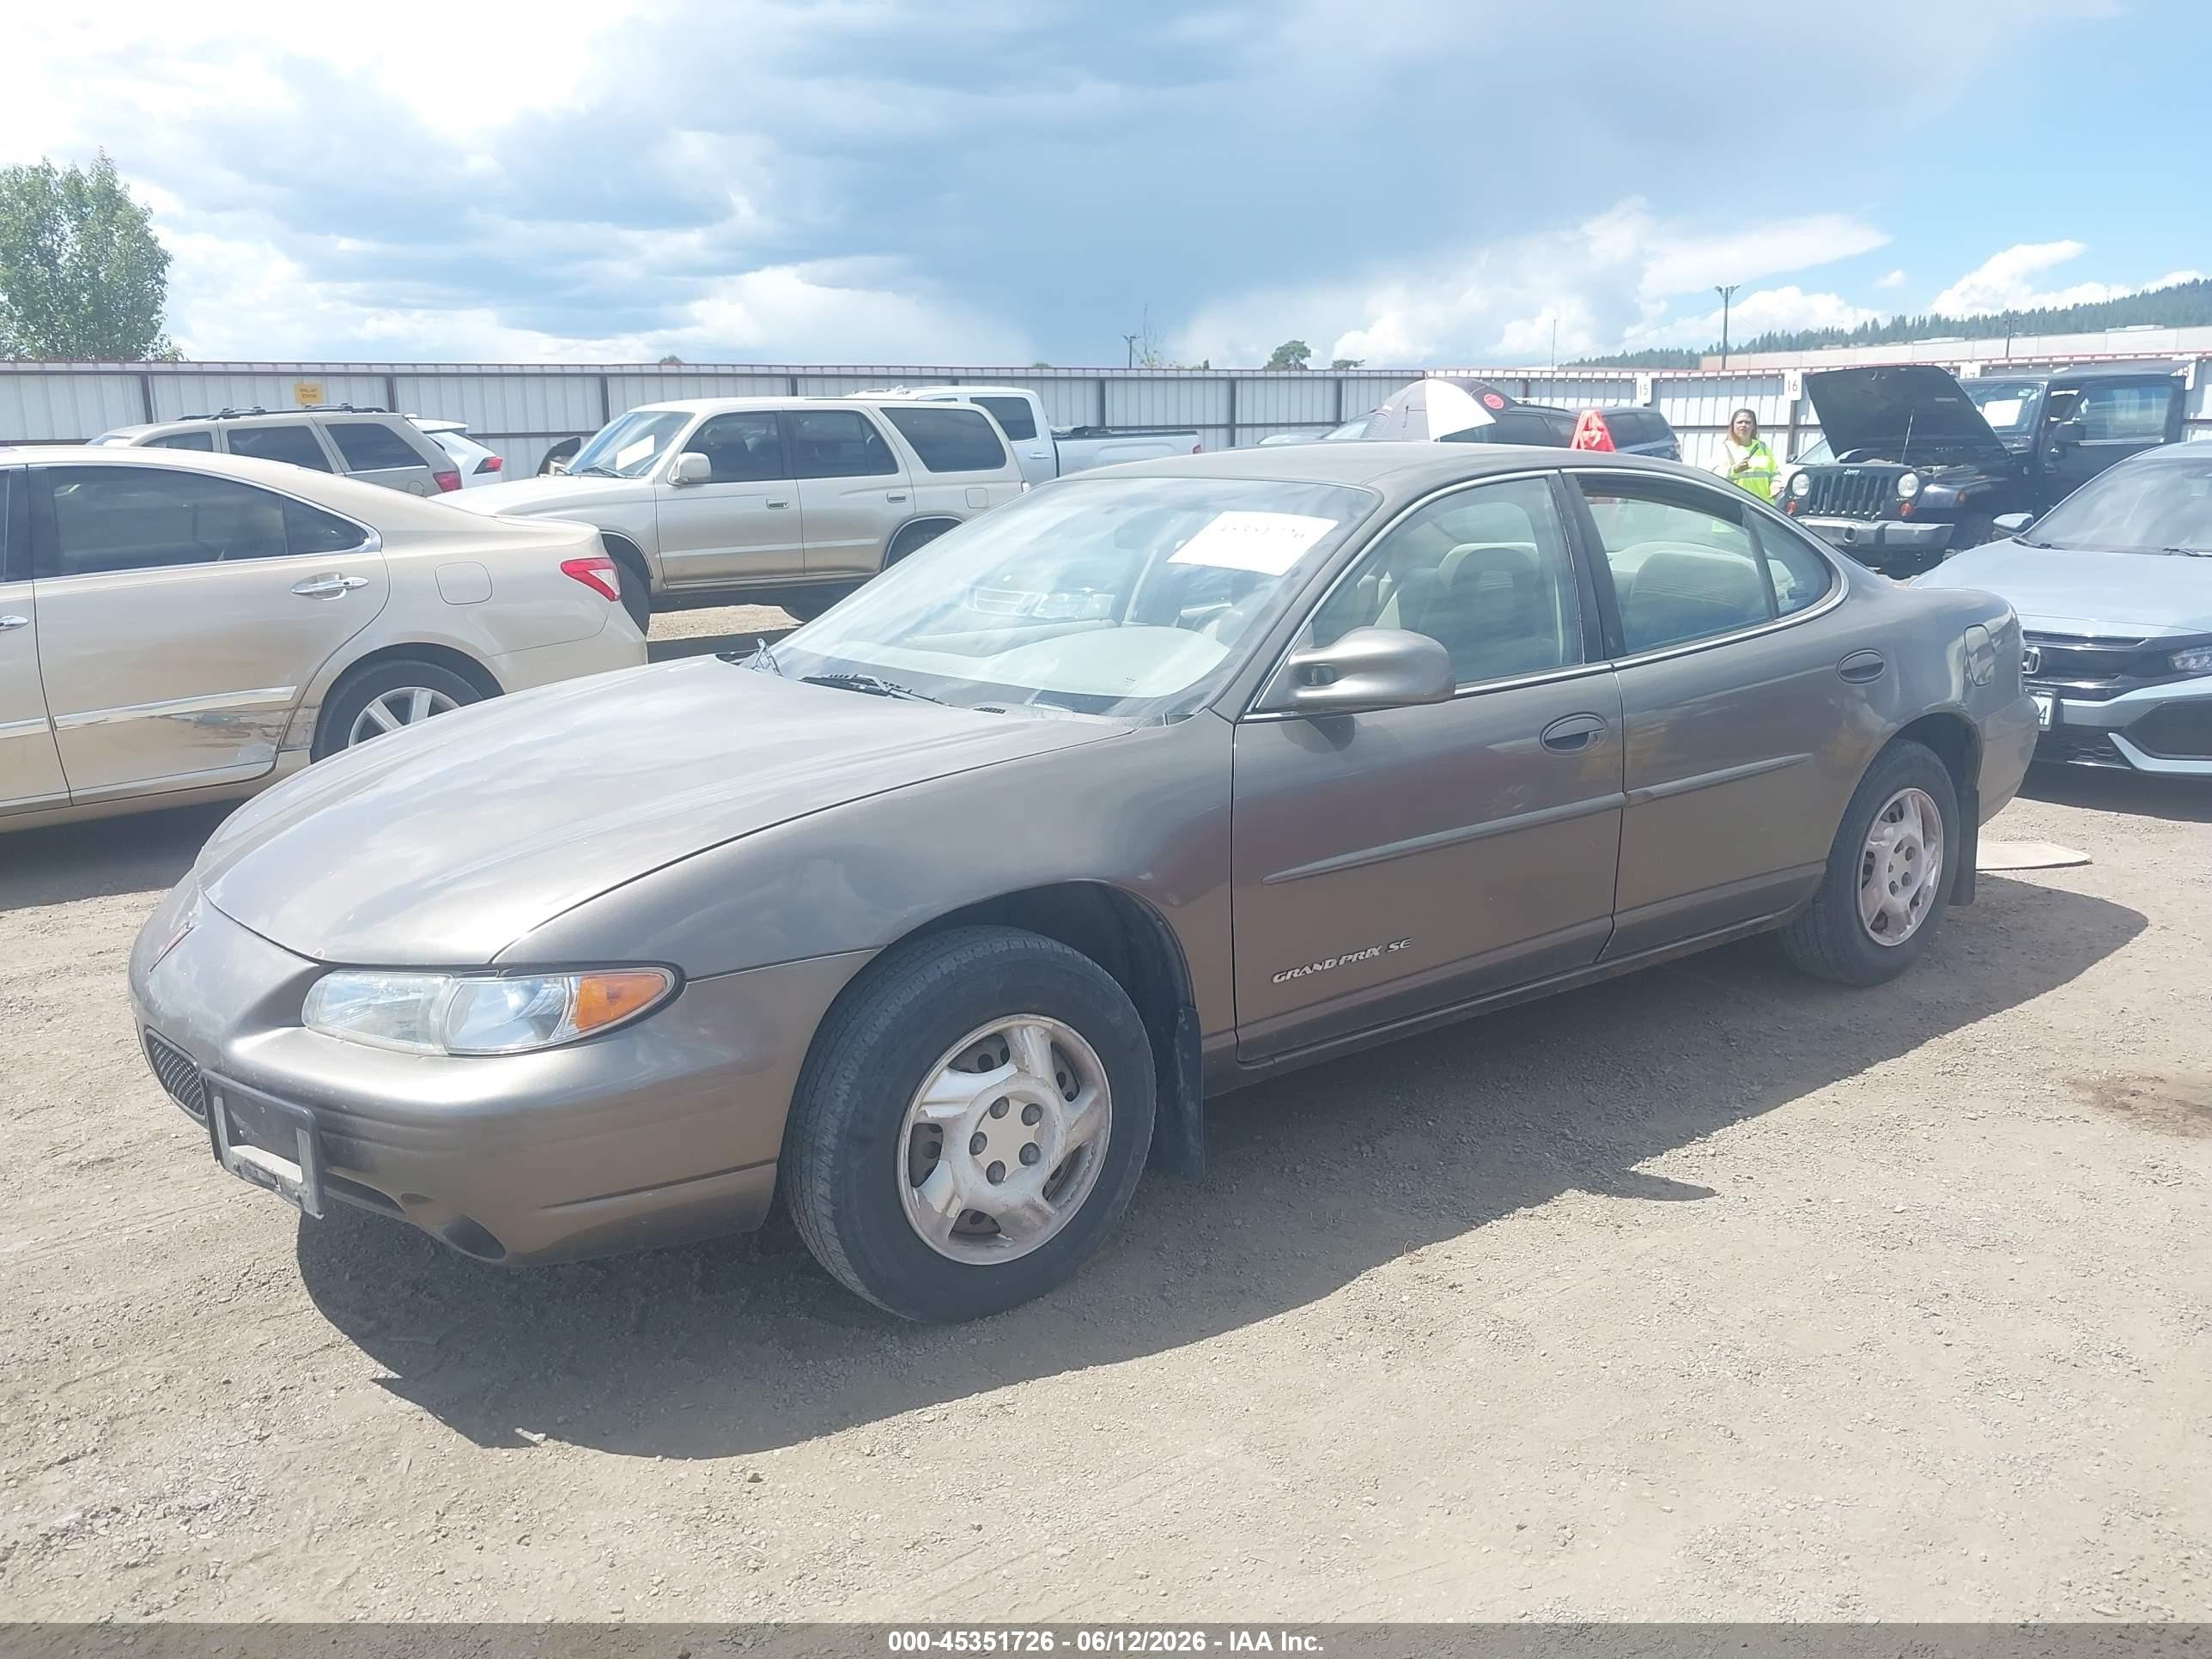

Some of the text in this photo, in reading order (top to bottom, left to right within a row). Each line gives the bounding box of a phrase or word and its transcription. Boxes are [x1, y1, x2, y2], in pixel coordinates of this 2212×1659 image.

[1639, 384, 1648, 396] 15
[1788, 380, 1798, 392] 16
[1272, 957, 1338, 983] GRAND
[1339, 945, 1382, 966] PRIX
